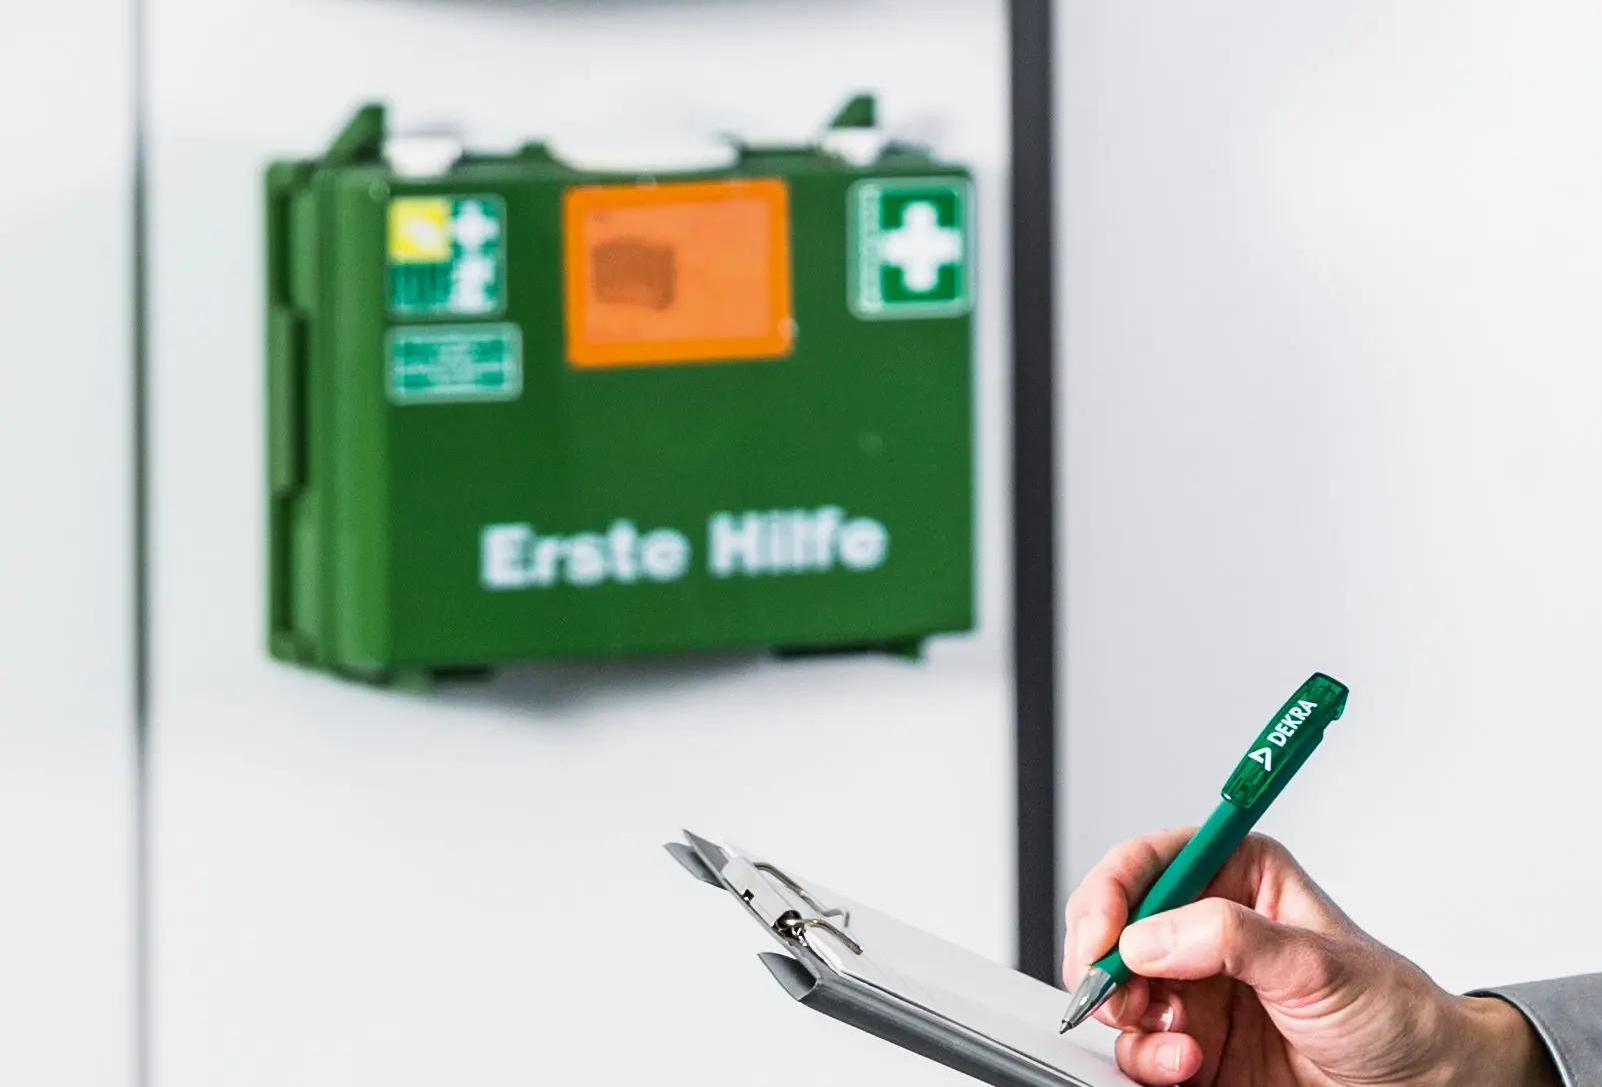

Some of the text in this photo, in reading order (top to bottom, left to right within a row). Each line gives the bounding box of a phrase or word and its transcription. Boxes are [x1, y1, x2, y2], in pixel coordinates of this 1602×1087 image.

[480, 505, 890, 590] Erste Hilfe
[1266, 699, 1318, 748] DEKRA
